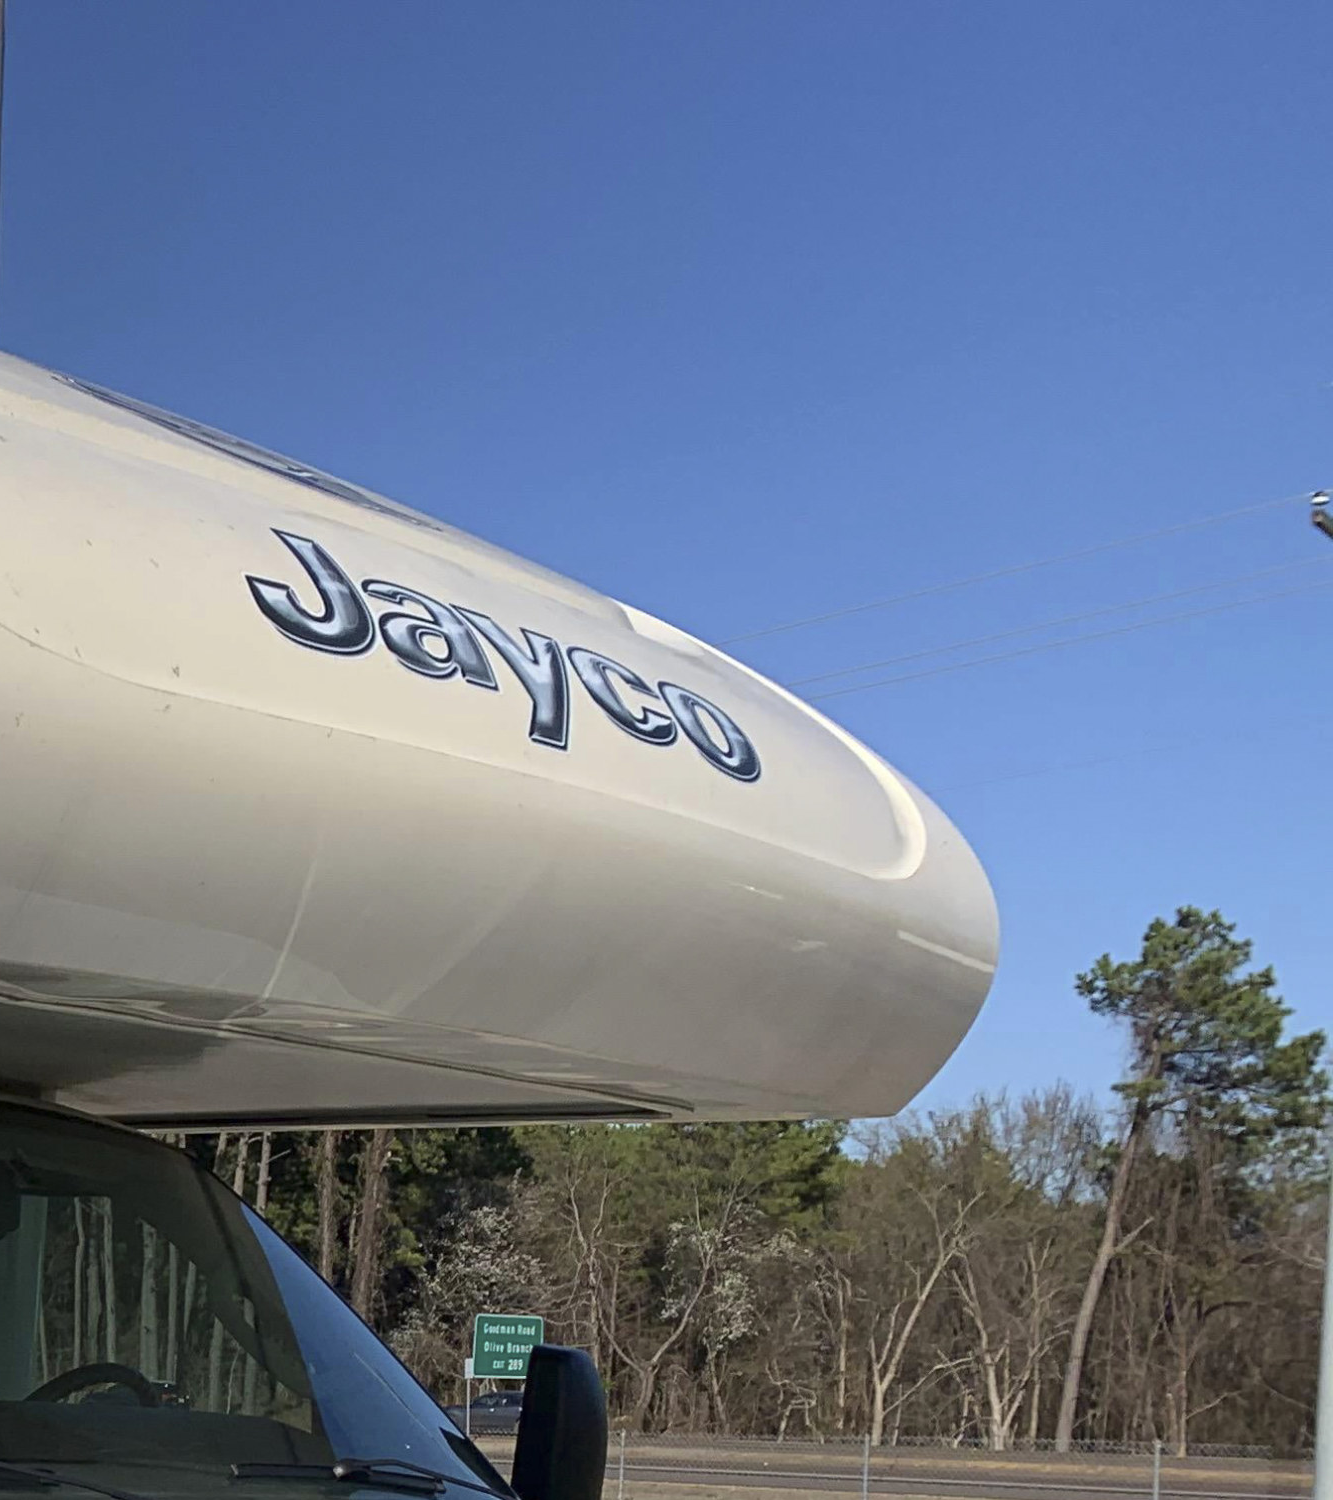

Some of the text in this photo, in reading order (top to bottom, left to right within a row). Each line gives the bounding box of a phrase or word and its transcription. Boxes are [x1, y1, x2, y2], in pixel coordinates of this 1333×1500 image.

[243, 526, 762, 784] Jayco
[483, 1322, 536, 1336] Goodman Road
[484, 1341, 504, 1353] Olive
[508, 1358, 524, 1371] 289
